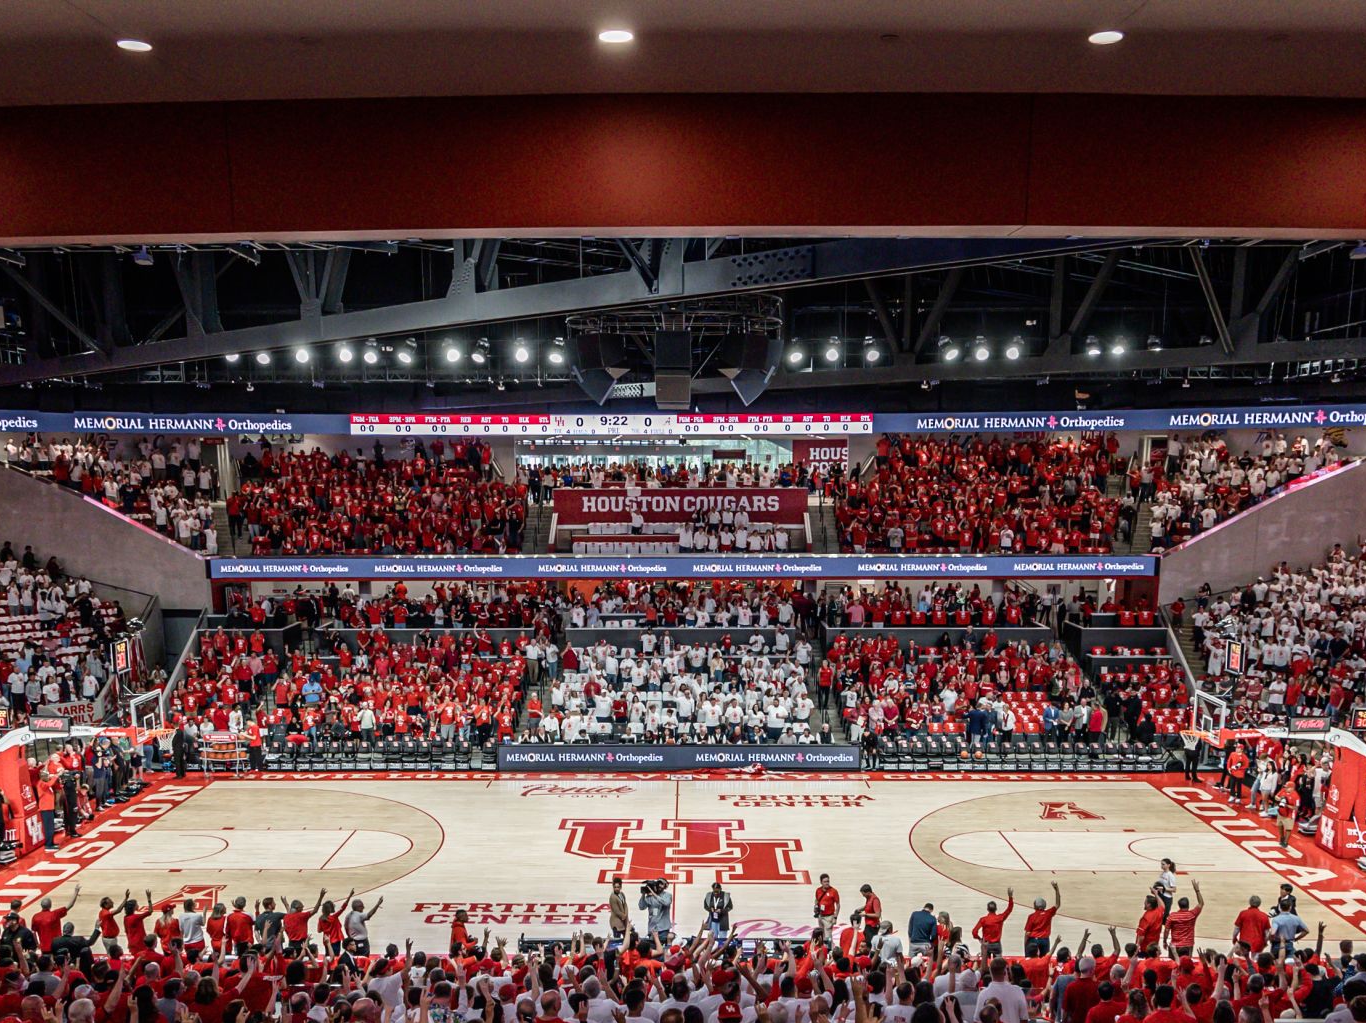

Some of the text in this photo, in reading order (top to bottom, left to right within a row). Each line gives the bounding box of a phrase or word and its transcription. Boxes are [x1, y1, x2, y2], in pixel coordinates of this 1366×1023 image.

[600, 416, 628, 426] 9:22
[917, 415, 1124, 430] MEMORIAL HERMANN Orthopedics
[1169, 413, 1240, 427] MEMORIAL
[1244, 411, 1314, 425] HERMANN
[74, 417, 292, 432] MEMORIAL HERMANN Orthopedics
[582, 495, 780, 513] HOUSTON COUGARS
[220, 565, 260, 573] MEMORIAL
[310, 565, 348, 574] Orthopedics
[374, 565, 414, 573] MEMORIAL
[464, 565, 502, 574] Orthopedics
[538, 565, 578, 573] MEMORIAL
[627, 565, 666, 574] Orthopedics
[693, 565, 733, 573] MEMORIAL
[783, 565, 822, 574] Orthopedics
[858, 564, 898, 572] MEMORIAL
[948, 564, 987, 573] Orthopedics
[1014, 563, 1054, 571] MEMORIAL
[1104, 563, 1144, 572] Orthopedics
[506, 752, 663, 764] MEMORIAL HERMANN Orthopedics
[695, 752, 853, 765] MEMORIAL HERMANN Orthopedics
[883, 773, 1132, 781] COURTSIDE
[558, 818, 812, 884] UH
[411, 902, 612, 913] FERTITTA
